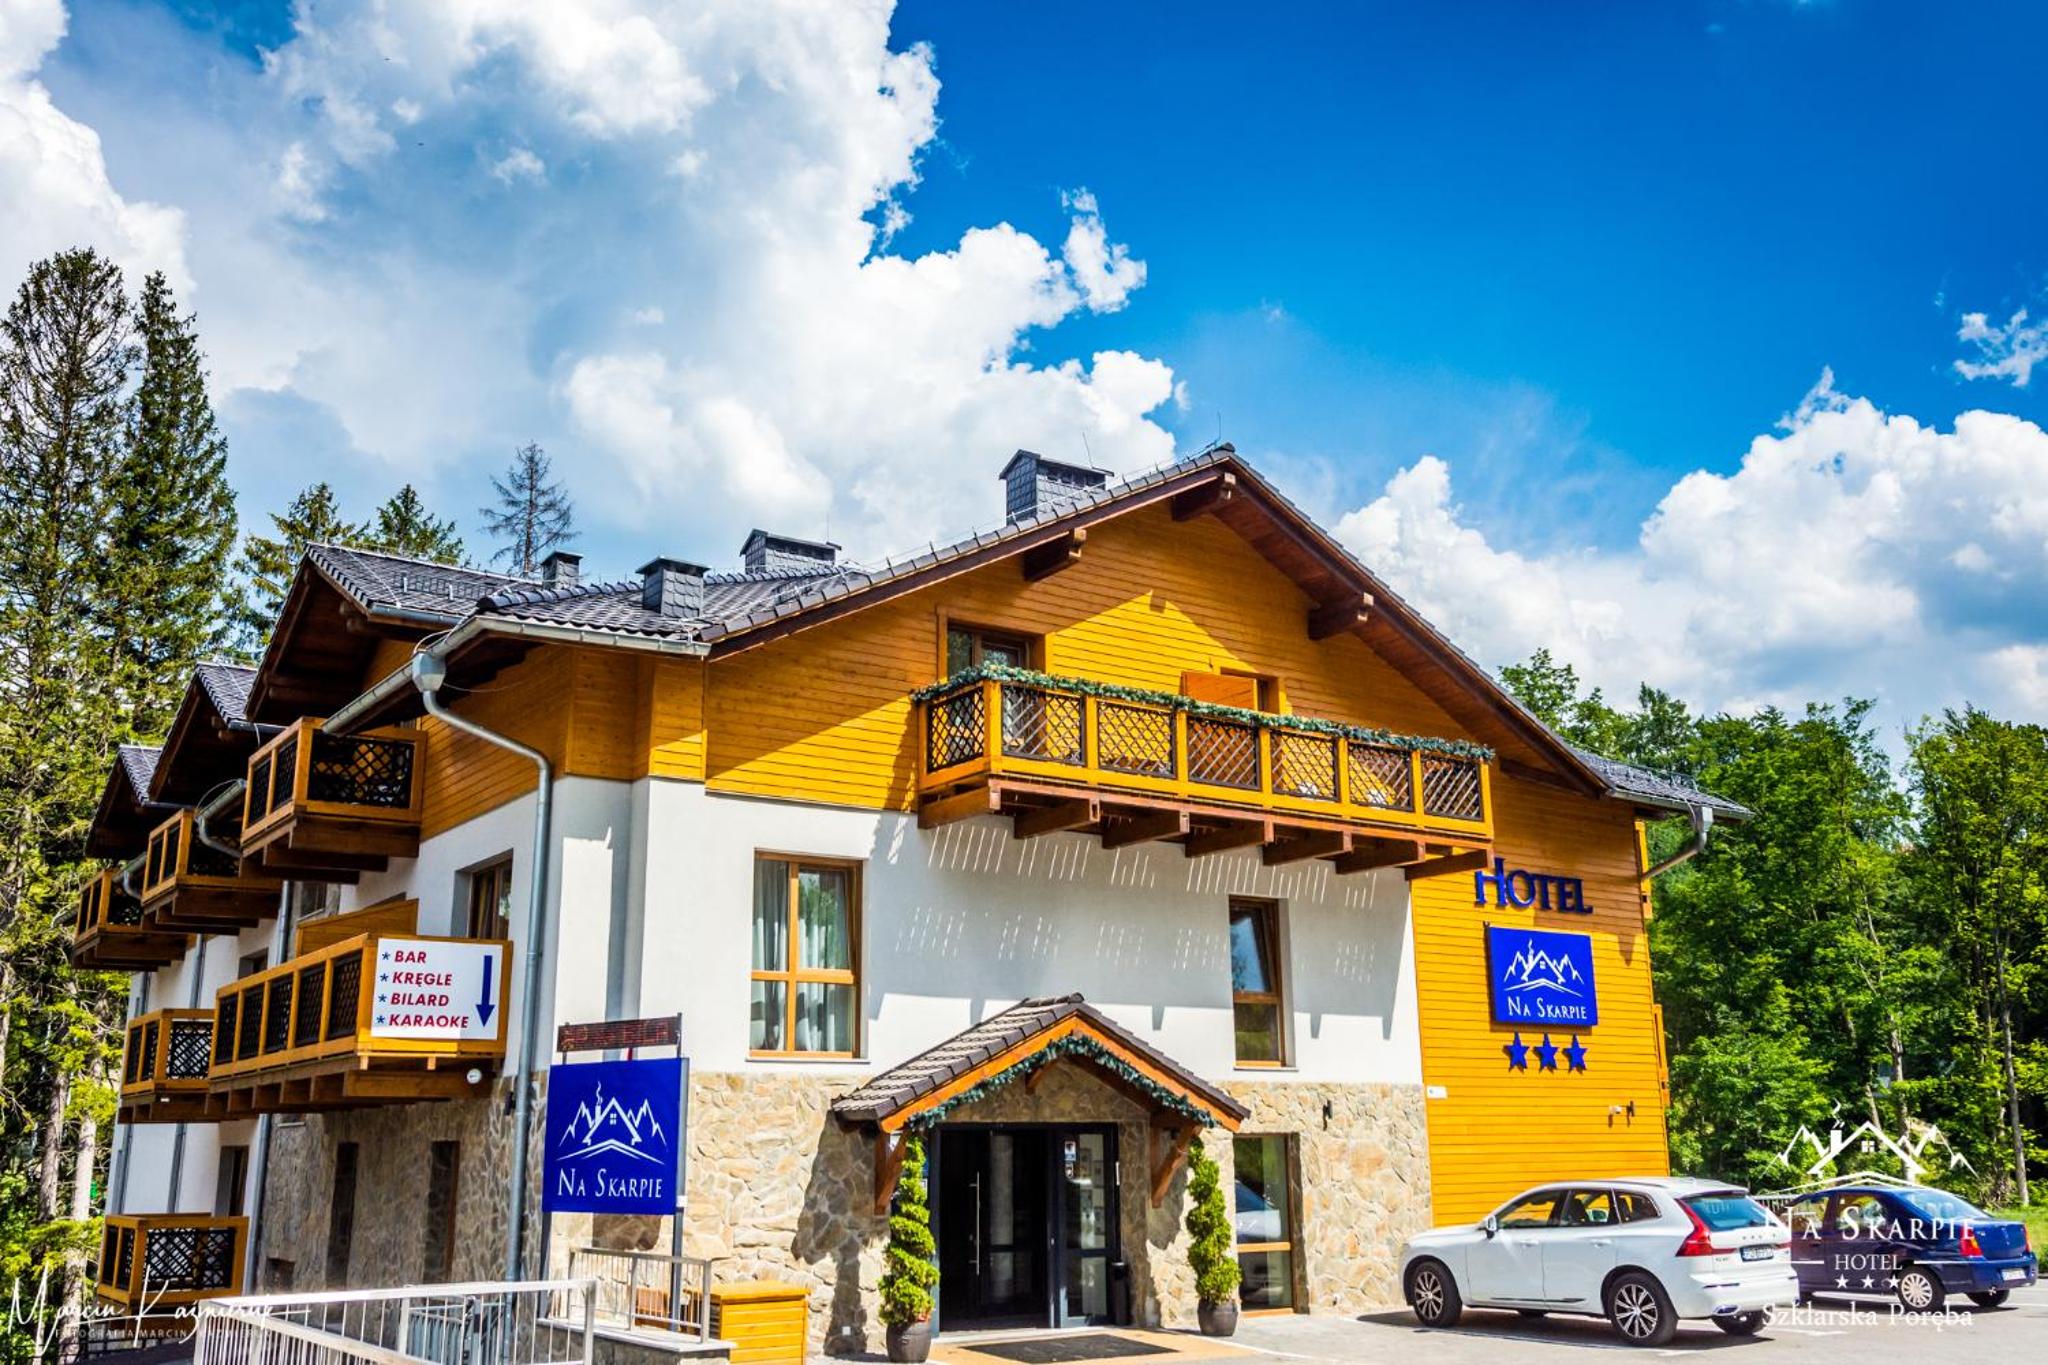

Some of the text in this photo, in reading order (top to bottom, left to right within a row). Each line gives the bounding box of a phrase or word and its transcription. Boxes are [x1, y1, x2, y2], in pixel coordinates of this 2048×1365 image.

[1474, 857, 1594, 914] HOTEL
[394, 950, 427, 963] BAR
[392, 971, 452, 987] KRĘGLE
[390, 993, 449, 1007] BILARD
[1507, 996, 1588, 1019] NA SKARPIE
[388, 1014, 469, 1028] KARAOKE
[558, 1167, 663, 1198] NA SKARPIE
